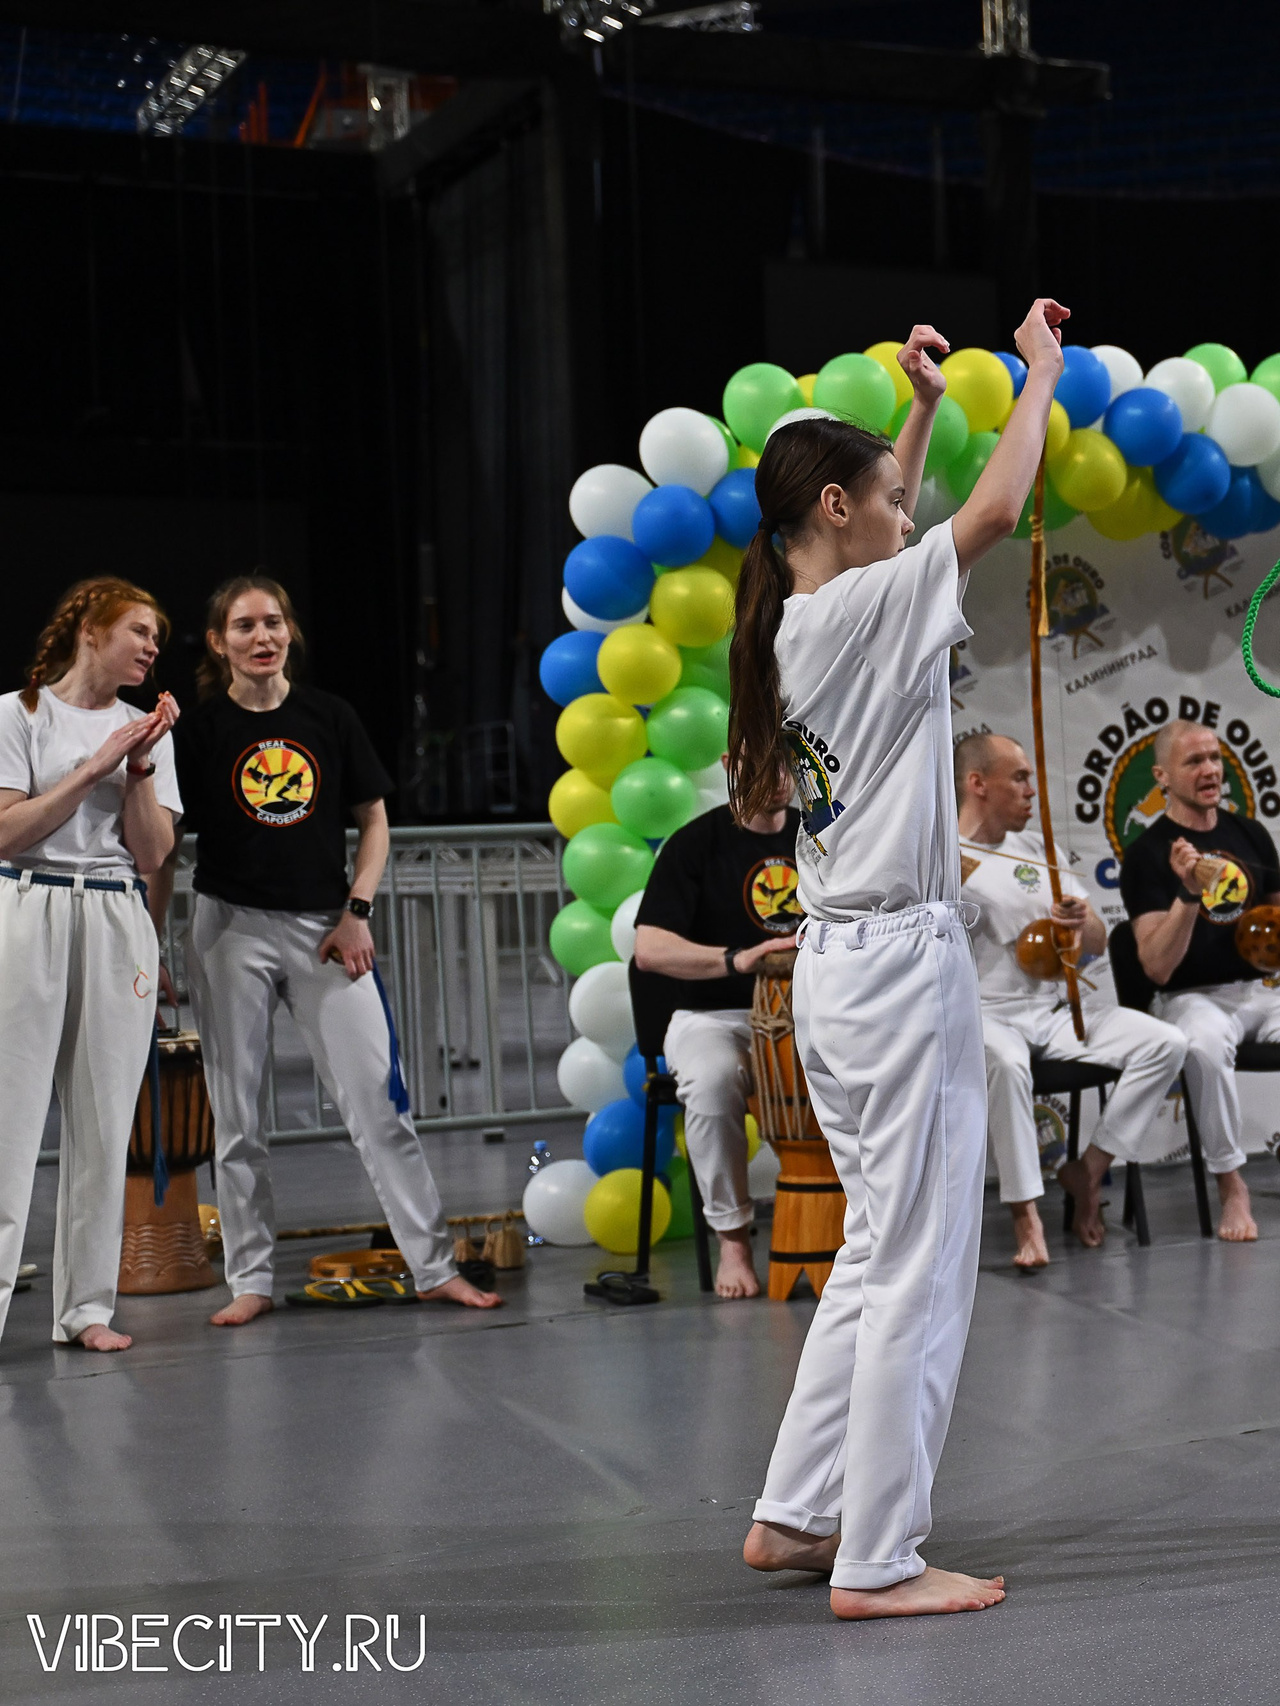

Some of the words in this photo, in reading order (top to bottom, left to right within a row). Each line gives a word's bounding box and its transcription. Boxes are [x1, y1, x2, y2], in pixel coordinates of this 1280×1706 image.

[1065, 645, 1159, 695] КАЛИНИНГРАД
[258, 740, 287, 751] REAL
[1075, 697, 1169, 824] CORDÃO
[1178, 695, 1221, 729] DE
[257, 809, 308, 825] CAPOEIRA
